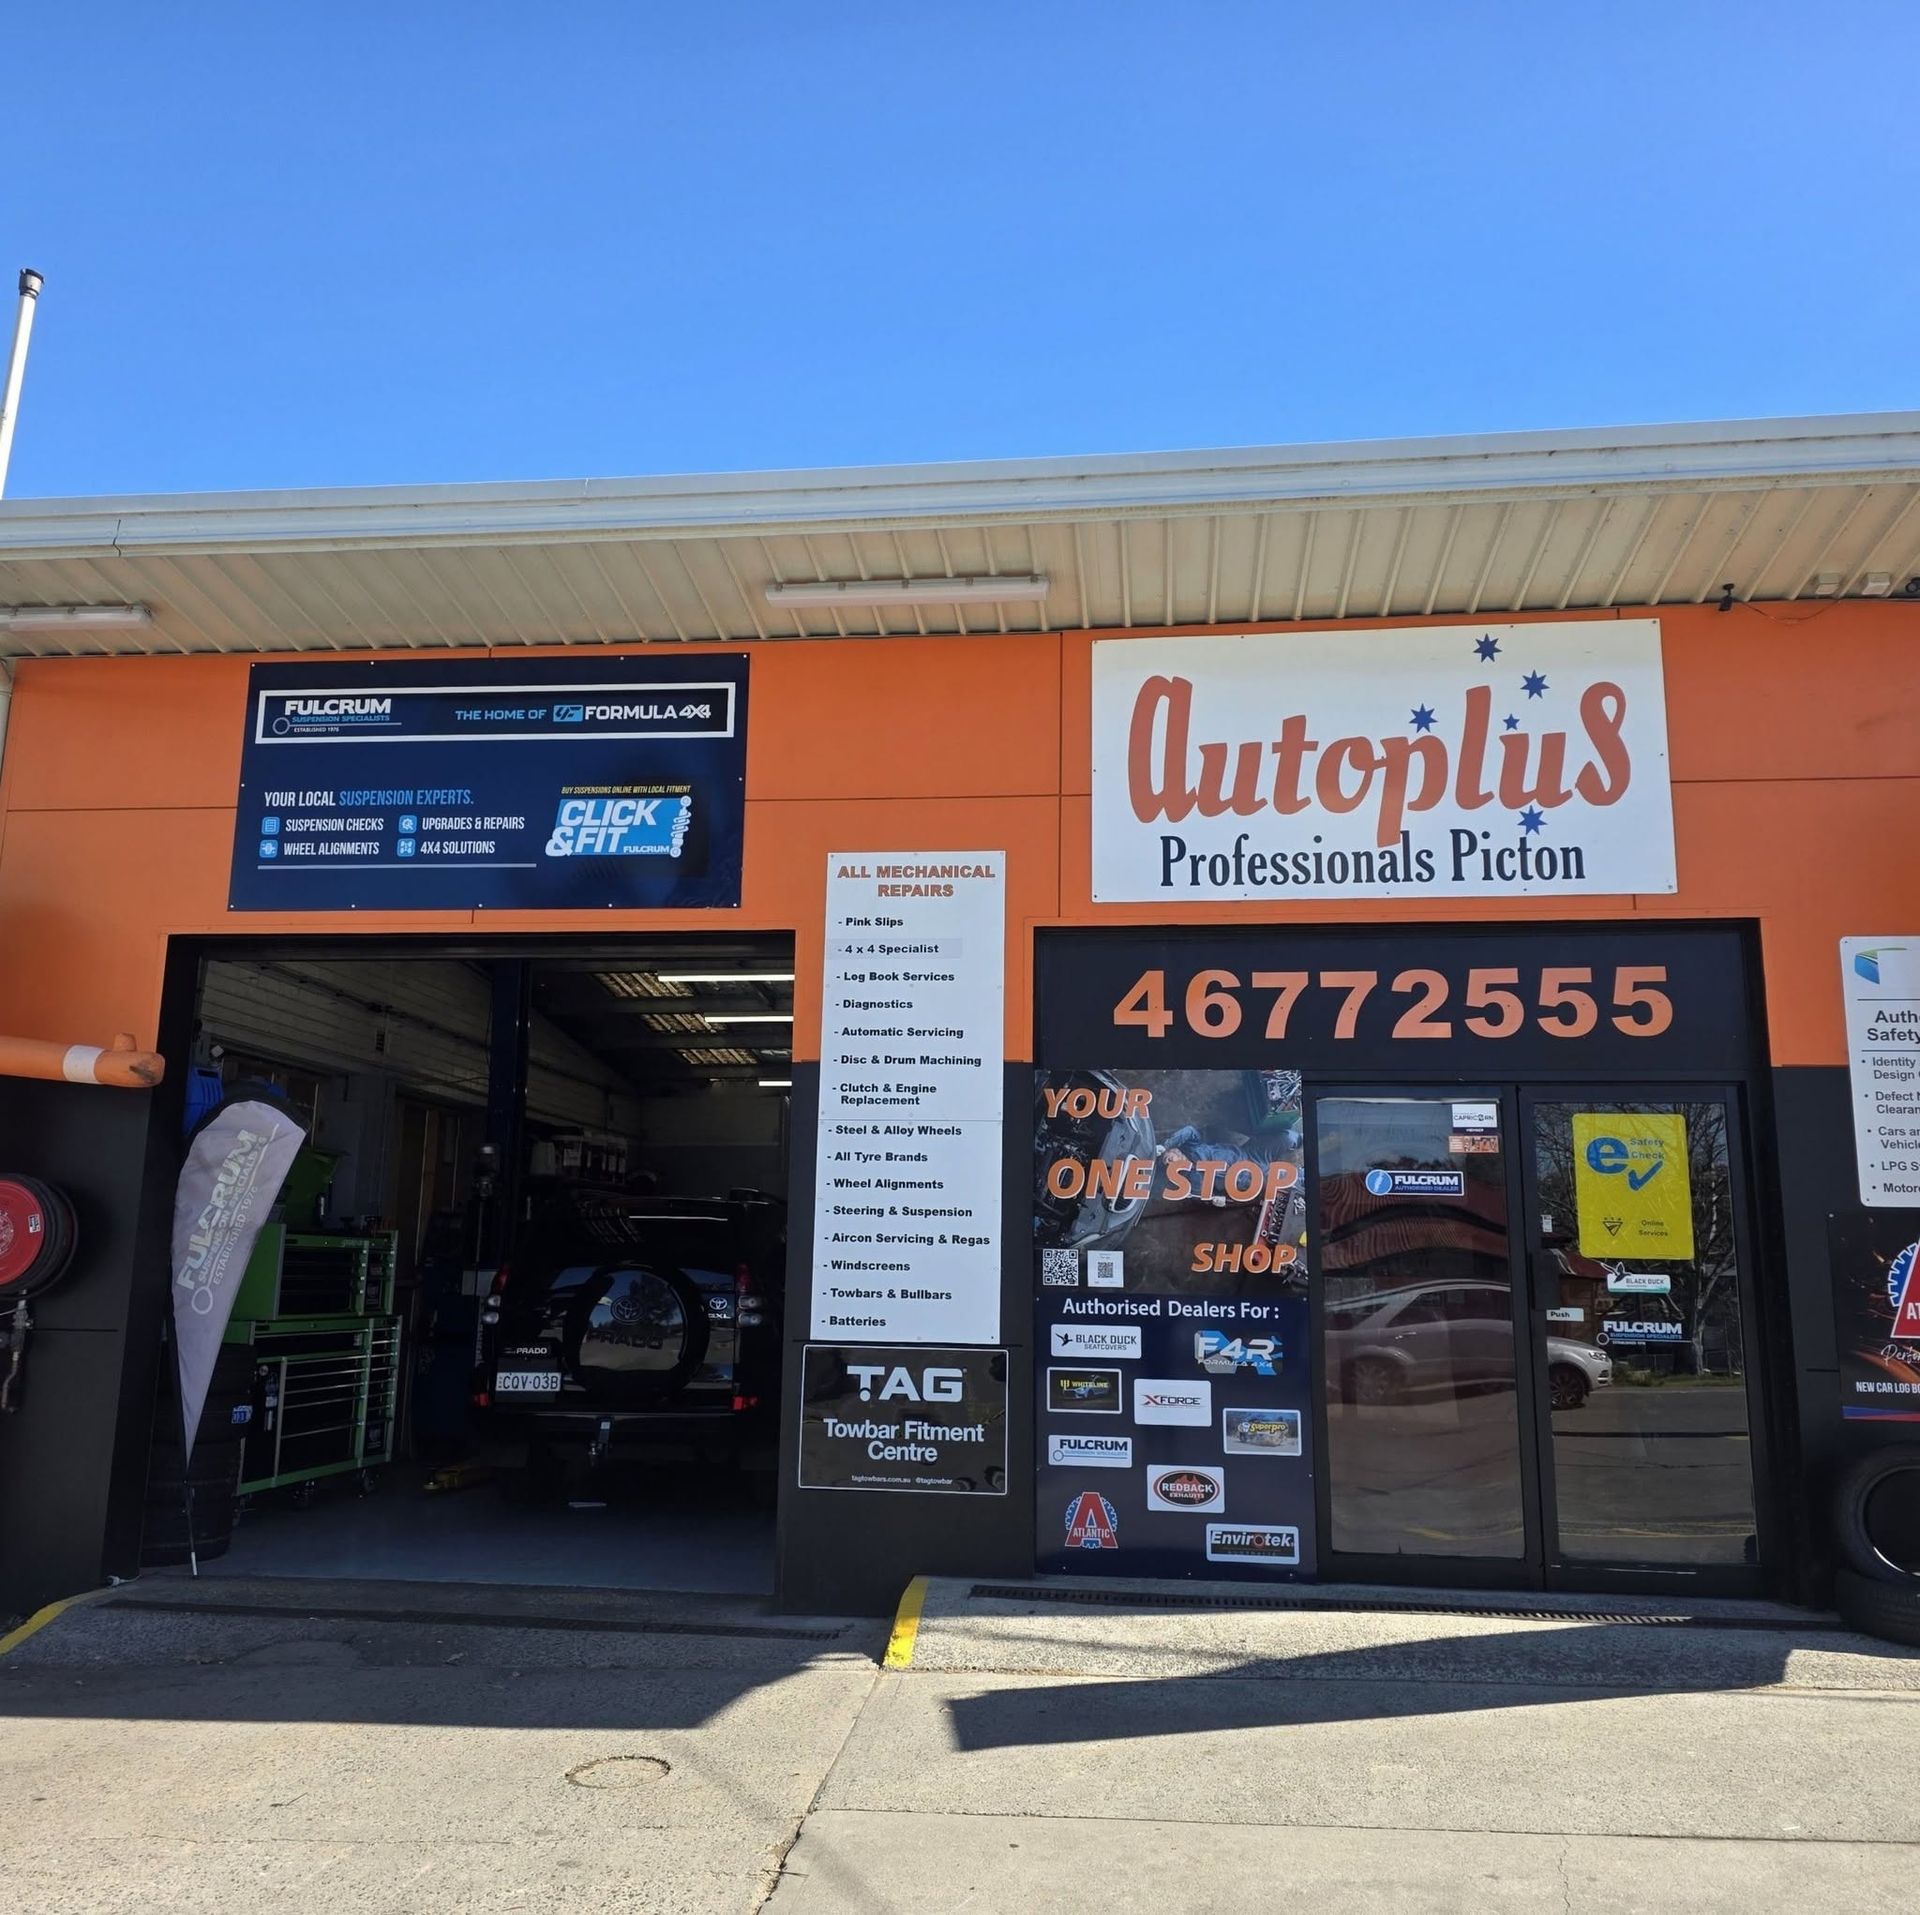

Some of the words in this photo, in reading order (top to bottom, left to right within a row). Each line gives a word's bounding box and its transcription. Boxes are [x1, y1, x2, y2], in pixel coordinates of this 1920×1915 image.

[284, 698, 392, 716] FULCRUM
[584, 705, 679, 720] FORMULA
[455, 709, 482, 720] THE
[484, 709, 525, 720] HOME
[528, 709, 547, 720] OF
[264, 791, 296, 807] YOUR
[298, 791, 336, 806] LOCAL
[339, 790, 414, 806] SUSPENSION
[416, 789, 475, 805] EXPERTS.
[560, 800, 663, 826] CLICK
[285, 818, 344, 832] SUSPENSION
[346, 818, 384, 831] CHECKS
[422, 817, 473, 831] UPGRADES
[474, 817, 482, 830] &
[483, 816, 525, 830] REPAIRS
[283, 842, 317, 856] WHEEL
[318, 841, 380, 856] ALIGNMENTS
[420, 841, 441, 855] 4X4
[442, 840, 496, 855] SOLUTIONS
[623, 845, 670, 854] FULCRUM
[1160, 830, 1436, 888] Professionals
[1450, 828, 1586, 884] Picton
[837, 865, 871, 878] ALL
[876, 864, 996, 878] MECHANICAL
[877, 884, 954, 897] REPAIRS
[845, 917, 871, 926] Pink
[874, 916, 904, 928] Slips
[845, 944, 852, 953] 4
[867, 944, 875, 953] 4
[878, 944, 939, 955] Specialist
[843, 972, 866, 983] Log
[869, 971, 899, 981] Book
[902, 971, 955, 981] Services
[842, 999, 913, 1010] Diagnostics
[1113, 965, 1674, 1040] 46772555
[1874, 1009, 1920, 1023] Auth
[841, 1027, 903, 1037] Automatic
[906, 1027, 964, 1039] Servicing
[840, 1055, 867, 1064] Disc
[871, 1055, 880, 1065] &
[884, 1055, 916, 1065] Drum
[919, 1055, 982, 1067] Machining
[1872, 1056, 1916, 1068] Identity
[1873, 1069, 1915, 1082] Design
[840, 1083, 879, 1093] Clutch
[882, 1083, 892, 1093] &
[896, 1083, 937, 1095] Engine
[840, 1095, 920, 1107] Replacement
[1875, 1091, 1914, 1101] Defect
[1043, 1087, 1153, 1119] YOUR
[835, 1125, 867, 1135] Steel
[870, 1125, 880, 1135] &
[883, 1125, 914, 1137] Alloy
[917, 1125, 963, 1136] Wheels
[1878, 1126, 1906, 1136] Cars
[1630, 1138, 1665, 1148] Safety
[1880, 1139, 1920, 1150] Vehicl
[834, 1151, 850, 1161] All
[854, 1151, 882, 1163] Tyre
[885, 1152, 928, 1162] Brands
[1631, 1151, 1665, 1160] Check
[1881, 1161, 1908, 1171] LPG
[833, 1178, 871, 1189] Wheel
[874, 1178, 944, 1191] Alignments
[1047, 1158, 1155, 1200] ONE
[1162, 1159, 1298, 1202] STOP
[1394, 1175, 1459, 1186] FULCRUM
[1883, 1182, 1920, 1193] Motor
[176, 1129, 258, 1290] FULCRUM
[832, 1205, 885, 1218] Steering
[888, 1206, 898, 1216] &
[901, 1206, 973, 1218] Suspension
[1641, 1219, 1664, 1227] Online
[1638, 1229, 1668, 1237] Services
[831, 1233, 872, 1243] Aircon
[875, 1233, 934, 1246] Servicing
[938, 1234, 948, 1244] &
[951, 1234, 991, 1247] Regas
[1191, 1242, 1297, 1274] SHOP
[830, 1260, 911, 1271] Windscreens
[830, 1287, 883, 1299] Towbars
[886, 1288, 897, 1299] &
[900, 1289, 952, 1300] Bullbars
[1062, 1298, 1161, 1316] Authorised
[1168, 1300, 1236, 1318] Dealers
[829, 1315, 887, 1326] Batteries
[1603, 1320, 1682, 1334] FULCRUM
[1075, 1334, 1107, 1344] BLACK
[1110, 1335, 1137, 1345] DUCK
[1197, 1359, 1248, 1367] FORMULA
[846, 1365, 964, 1403] TAG
[1856, 1381, 1876, 1393] NEW
[1876, 1382, 1893, 1393] CAR
[1894, 1382, 1910, 1394] LOG
[823, 1417, 900, 1439] Towbar
[904, 1420, 985, 1442] Fitment
[867, 1440, 938, 1462] Centre
[1059, 1439, 1128, 1451] FULCRUM
[1162, 1483, 1213, 1493] REDBACK
[1072, 1527, 1111, 1539] ATLANTIC
